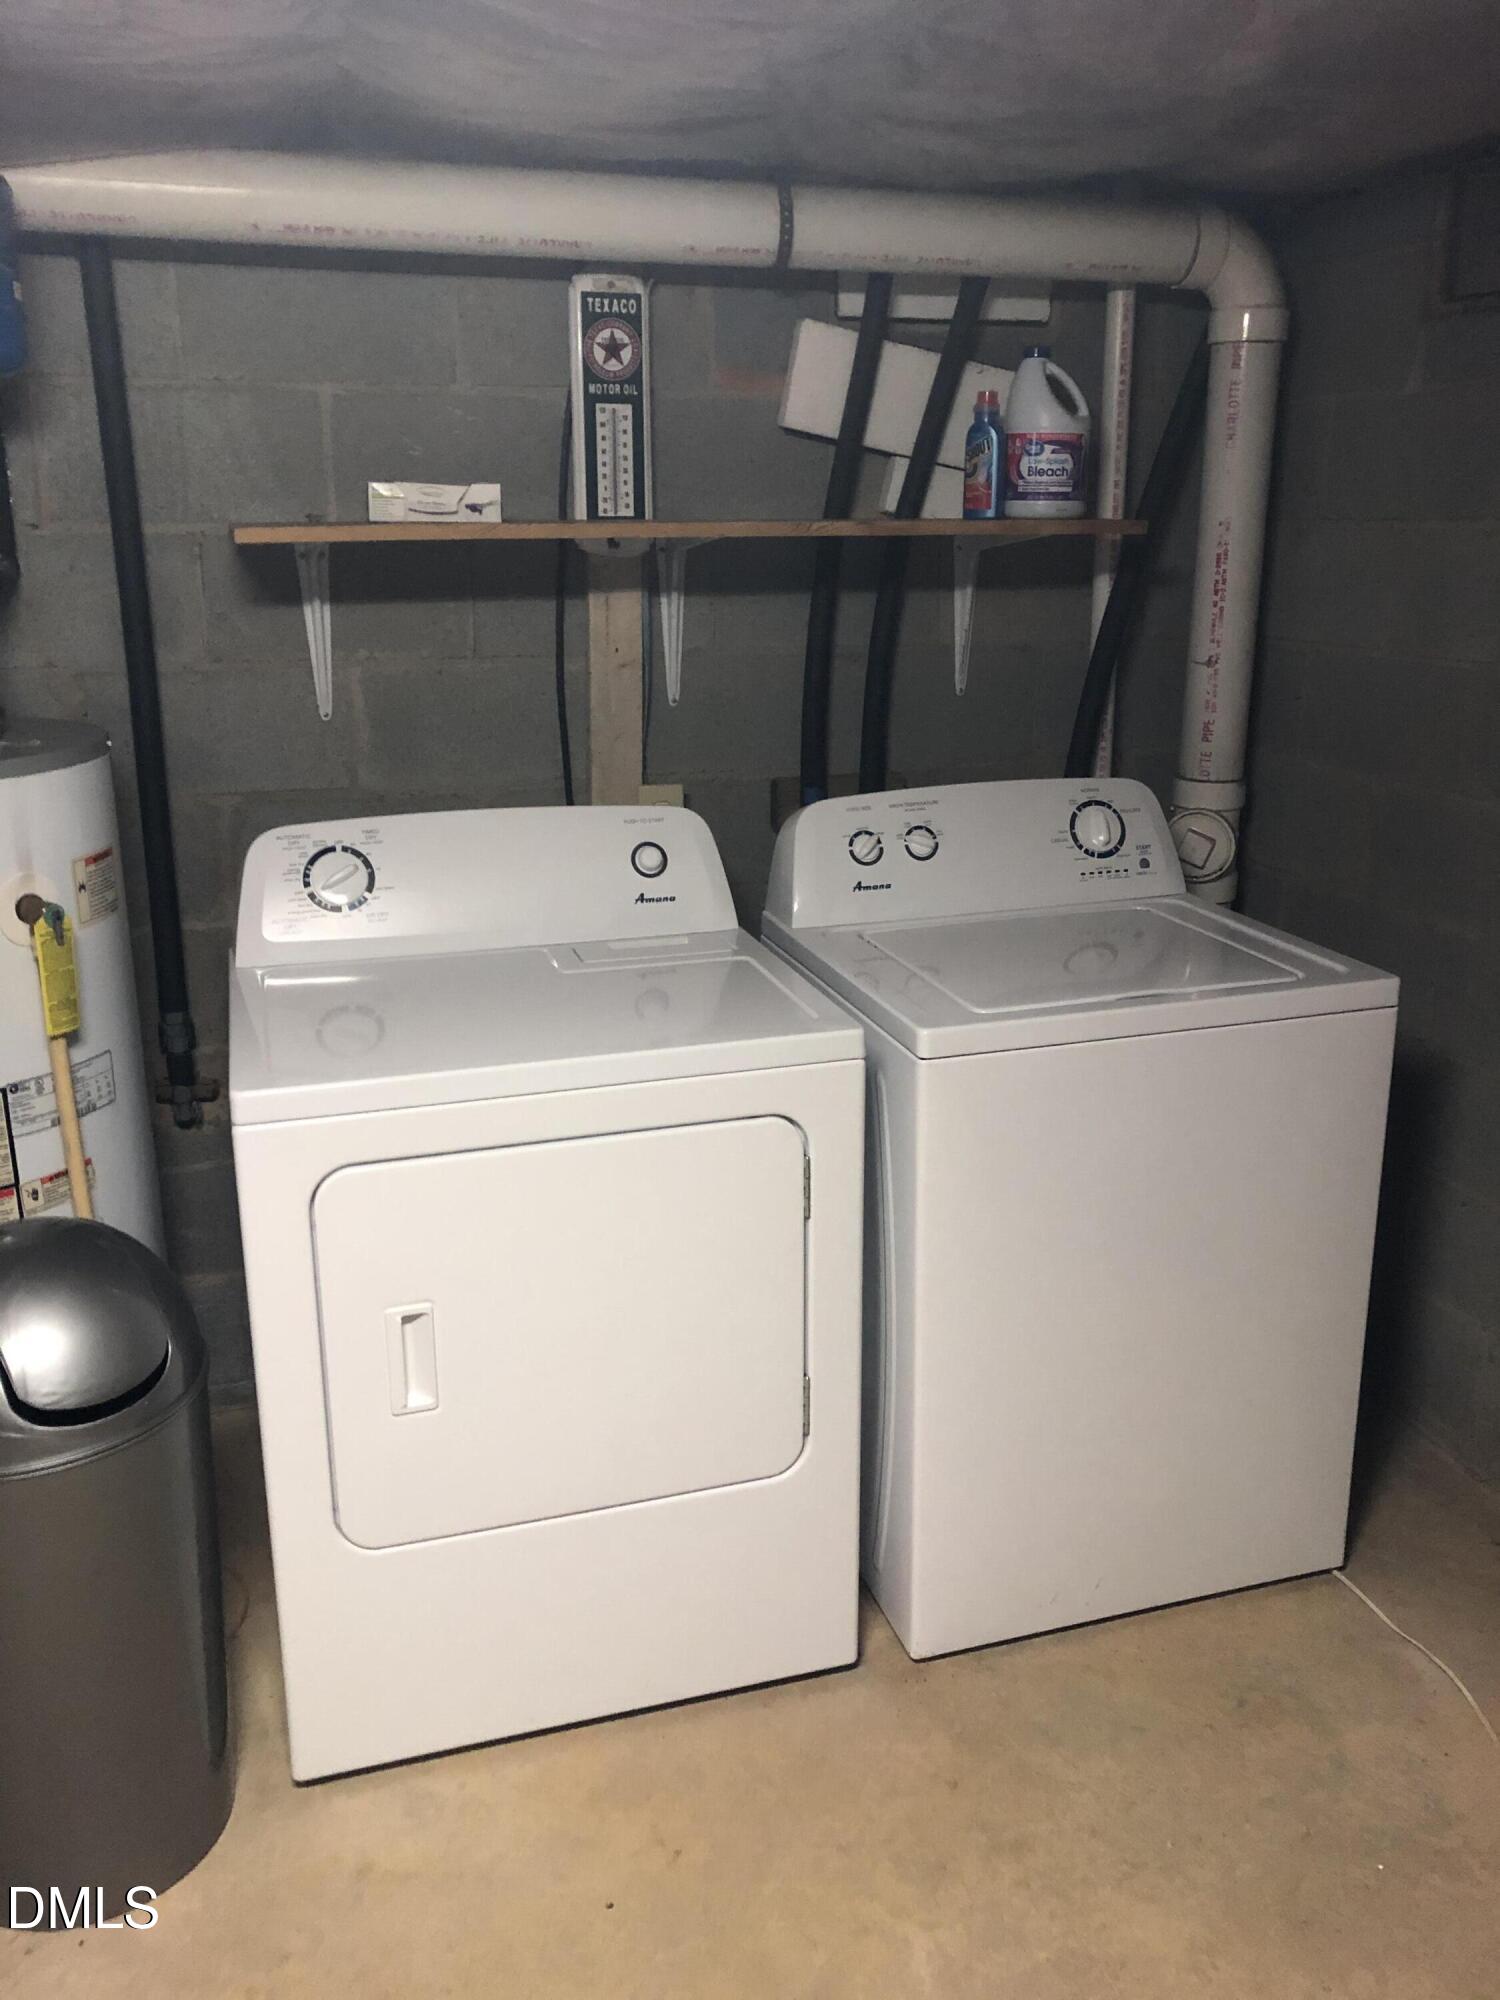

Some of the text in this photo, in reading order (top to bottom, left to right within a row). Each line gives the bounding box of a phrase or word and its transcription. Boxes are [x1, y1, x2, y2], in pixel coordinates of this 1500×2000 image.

[587, 297, 637, 314] TEXACO
[588, 383, 639, 395] MOTOR OIL
[1026, 465, 1069, 478] Bleach
[1200, 719, 1216, 743] PIPE
[852, 881, 892, 893] Amana
[634, 892, 676, 905] Amana
